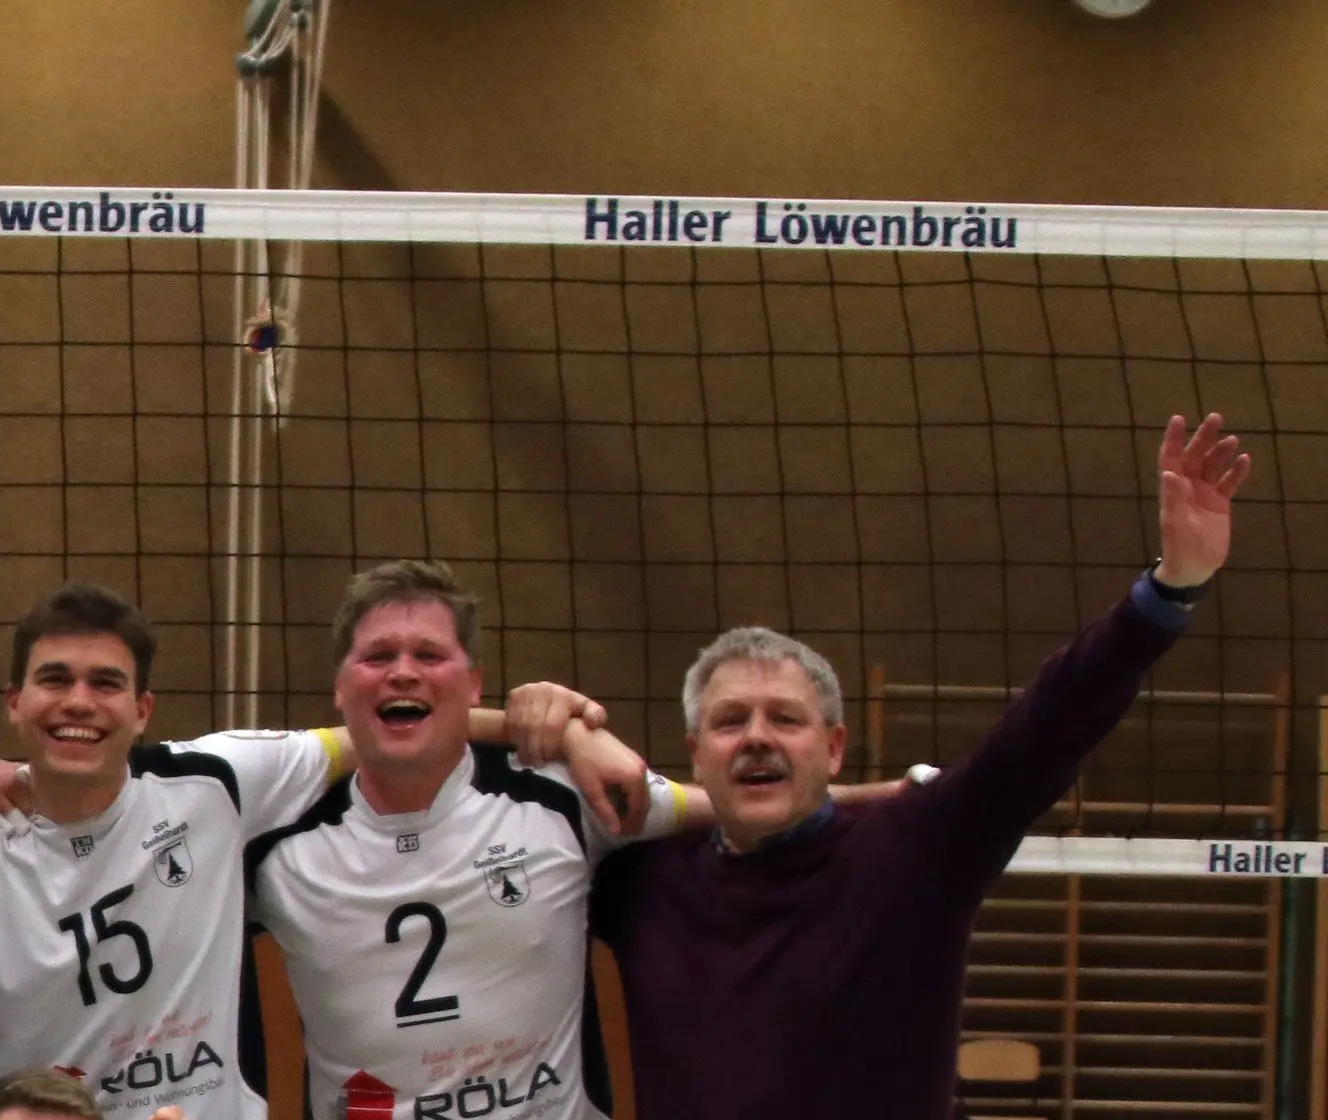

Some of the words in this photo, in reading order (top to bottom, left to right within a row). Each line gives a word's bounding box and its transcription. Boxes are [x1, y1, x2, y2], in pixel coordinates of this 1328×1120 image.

[585, 198, 730, 241] Haller
[756, 201, 1016, 248] Löwenbräu
[153, 820, 169, 833] SSV
[489, 844, 506, 855] SSV
[1210, 844, 1307, 873] Haller
[59, 883, 153, 1006] 15
[385, 902, 458, 1017] 2
